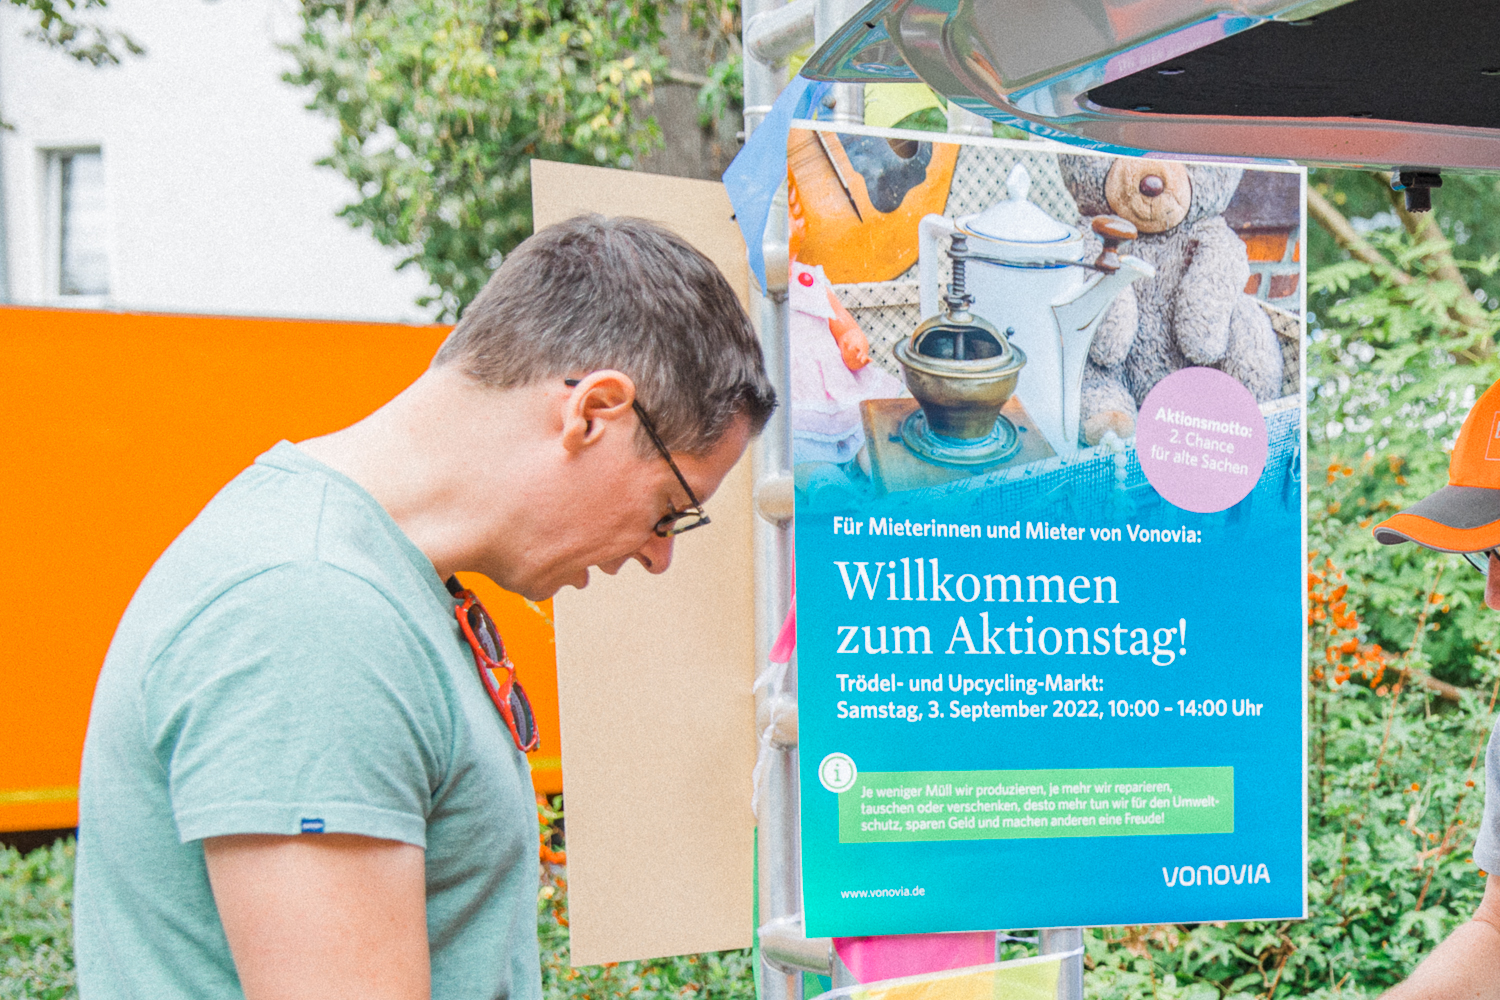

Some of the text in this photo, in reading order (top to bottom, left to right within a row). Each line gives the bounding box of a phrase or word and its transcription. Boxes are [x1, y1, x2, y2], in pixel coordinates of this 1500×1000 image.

[1155, 407, 1253, 438] Aktionsmotto:
[1170, 429, 1235, 454] 2. Chance
[1151, 445, 1248, 476] für alte Sachen
[833, 515, 1202, 544] Für Mieterinnen und Mieter von Vonovia:
[833, 556, 1120, 605] Willkommen
[836, 611, 1187, 667] zum Aktionstag!
[835, 673, 1104, 697] Trödel- und Upcycling-Markt:
[836, 700, 924, 723] Samstag,
[927, 699, 945, 719] 3.
[949, 699, 1049, 723] September
[1052, 699, 1104, 720] 2022,
[1107, 699, 1160, 718] 10:00
[1176, 698, 1228, 717] 14:00
[1231, 698, 1264, 717] Uhr
[861, 781, 1172, 799] Je weniger Müll wir produzieren, je mehr wir reparieren,
[861, 796, 1219, 815] tauschen oder verschenken, desto mehr tun wir für den Umwelt-
[861, 812, 1165, 831] schutz, sparen Geld und machen anderen eine Freude!
[1161, 862, 1271, 888] VONOVIA
[840, 885, 926, 899] www.vonovia.de
